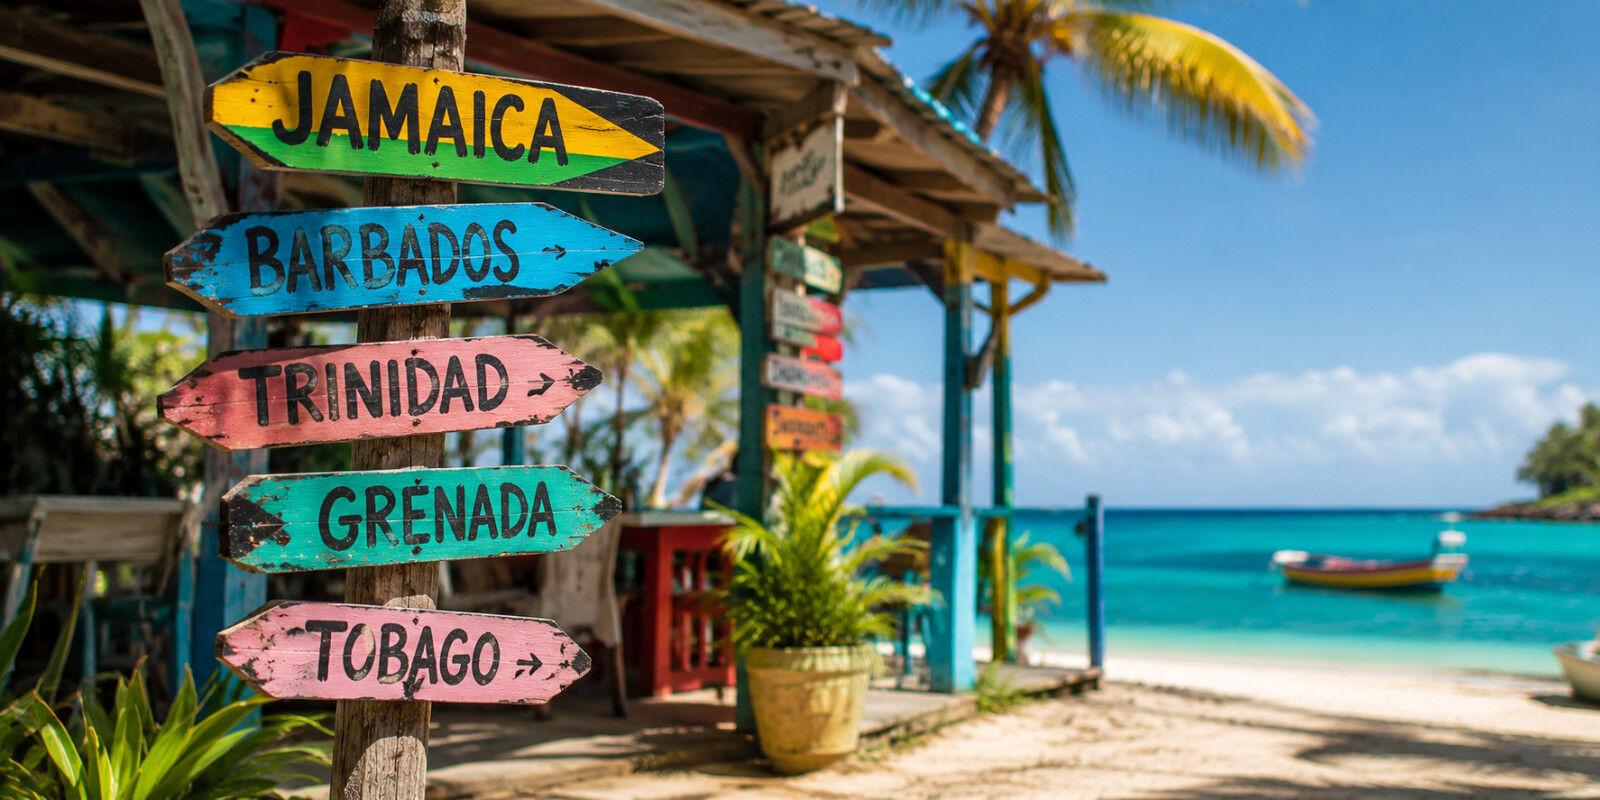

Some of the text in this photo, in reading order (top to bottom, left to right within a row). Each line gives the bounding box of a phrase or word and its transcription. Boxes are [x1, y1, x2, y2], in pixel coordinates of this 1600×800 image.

[271, 70, 569, 166] JAMAICA
[245, 219, 520, 296] BARBADOS
[238, 353, 509, 426] TRINIDAD
[318, 481, 557, 551] GRENADA
[305, 620, 500, 686] TOBAGO
